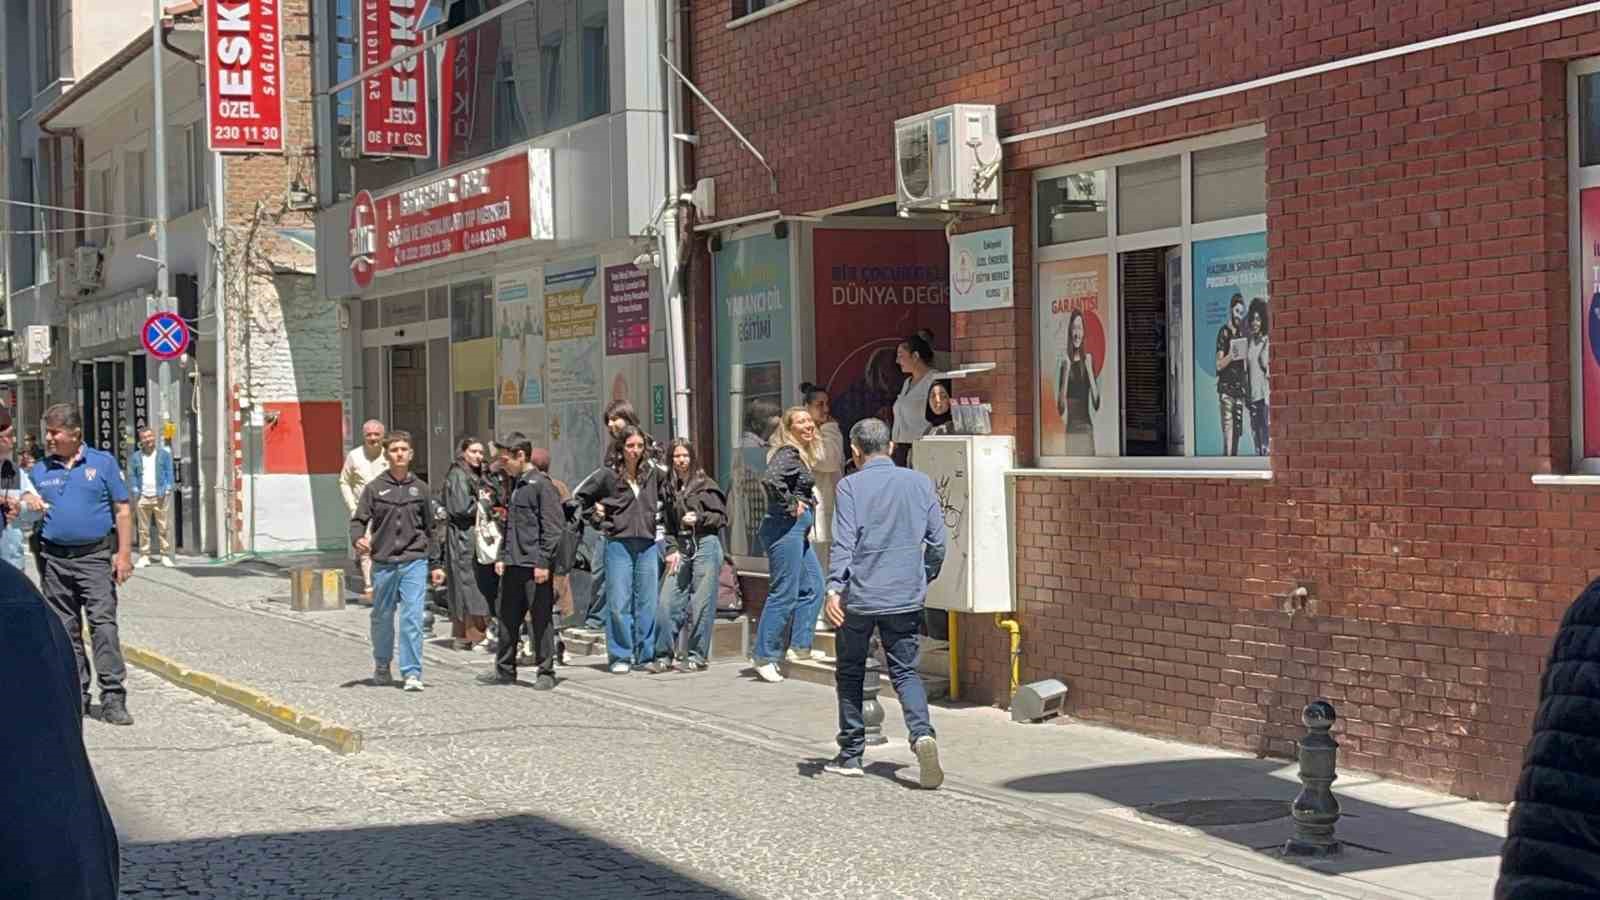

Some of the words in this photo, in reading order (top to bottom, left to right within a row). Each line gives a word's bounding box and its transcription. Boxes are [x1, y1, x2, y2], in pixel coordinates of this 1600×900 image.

[259, 25, 275, 96] SAĞLIĞI
[219, 99, 260, 119] ÖZEL
[215, 126, 240, 140] 230
[243, 126, 258, 140] 11
[262, 126, 279, 140] 30
[832, 283, 897, 305] DÜNYA
